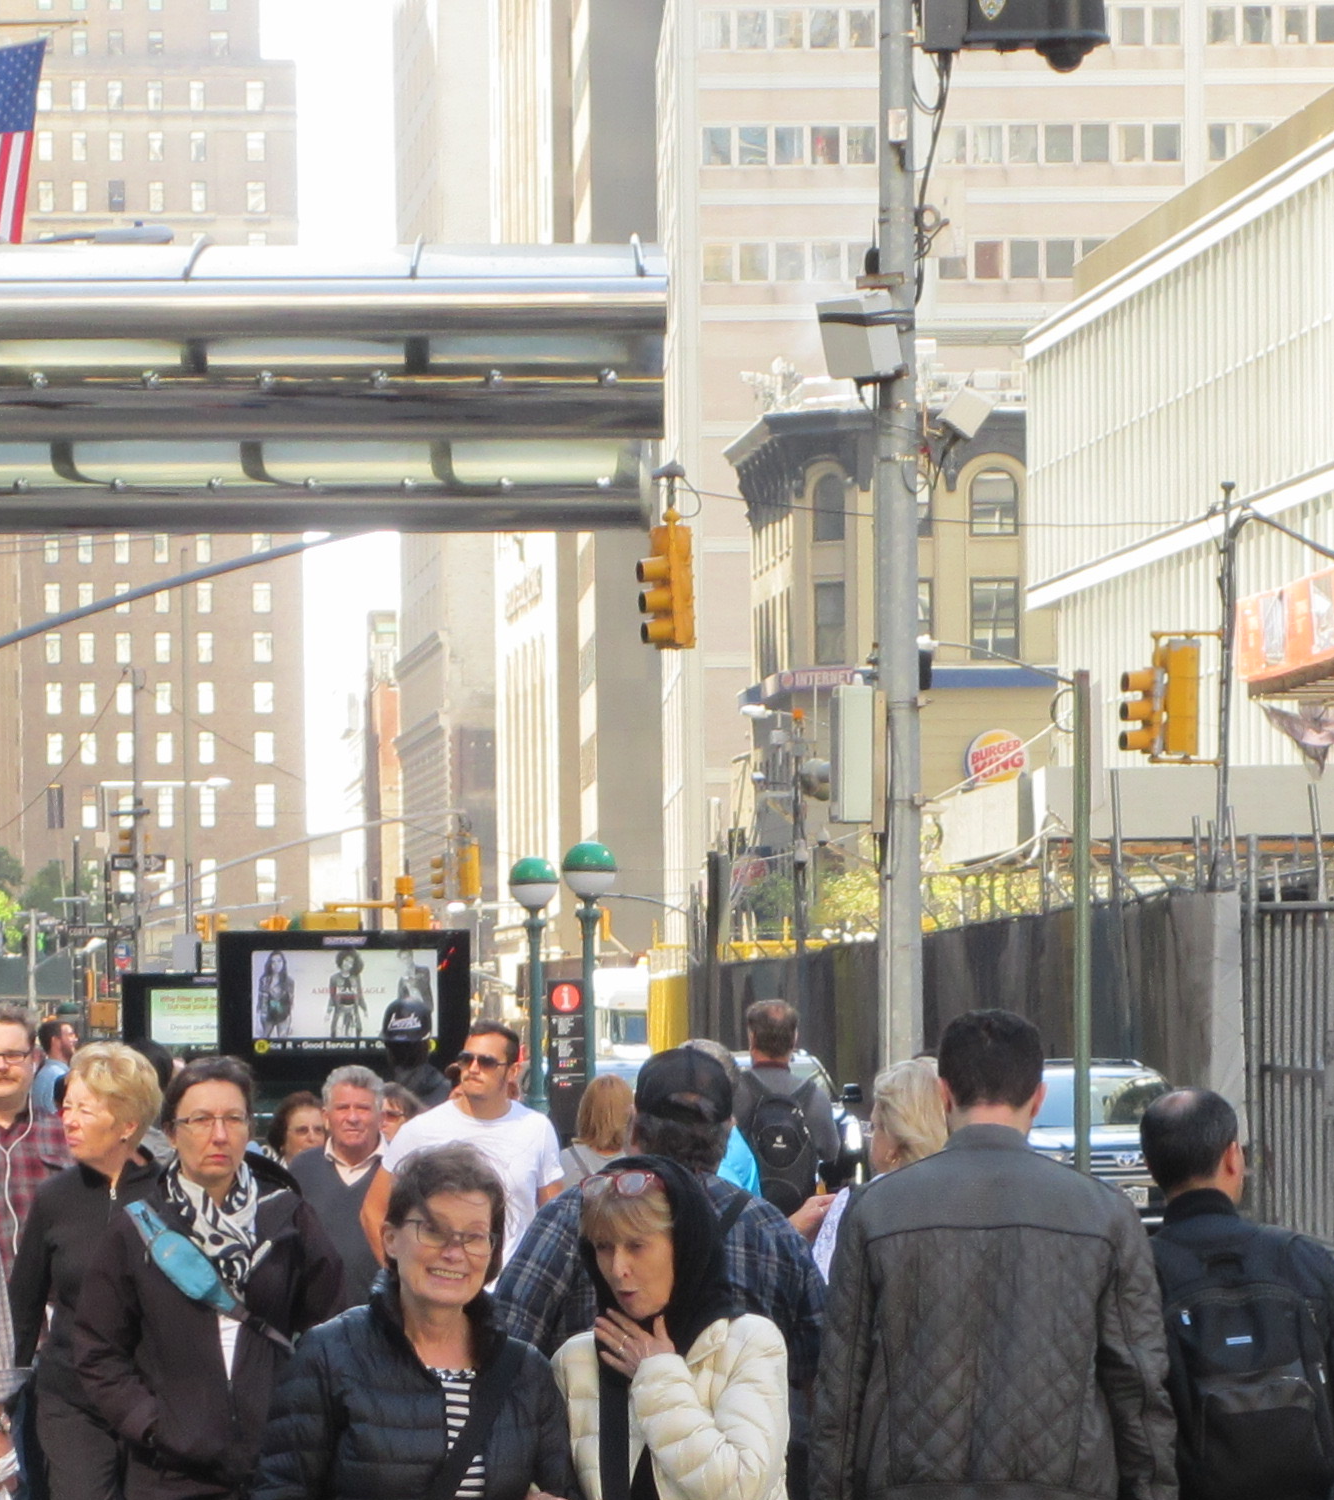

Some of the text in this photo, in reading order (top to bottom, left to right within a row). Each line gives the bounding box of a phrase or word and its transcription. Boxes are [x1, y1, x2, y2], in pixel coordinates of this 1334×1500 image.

[795, 669, 855, 687] INTERNET
[971, 738, 1022, 766] BURGER
[973, 752, 1025, 784] KING
[302, 1041, 325, 1050] Good
[326, 1041, 356, 1050] Service
